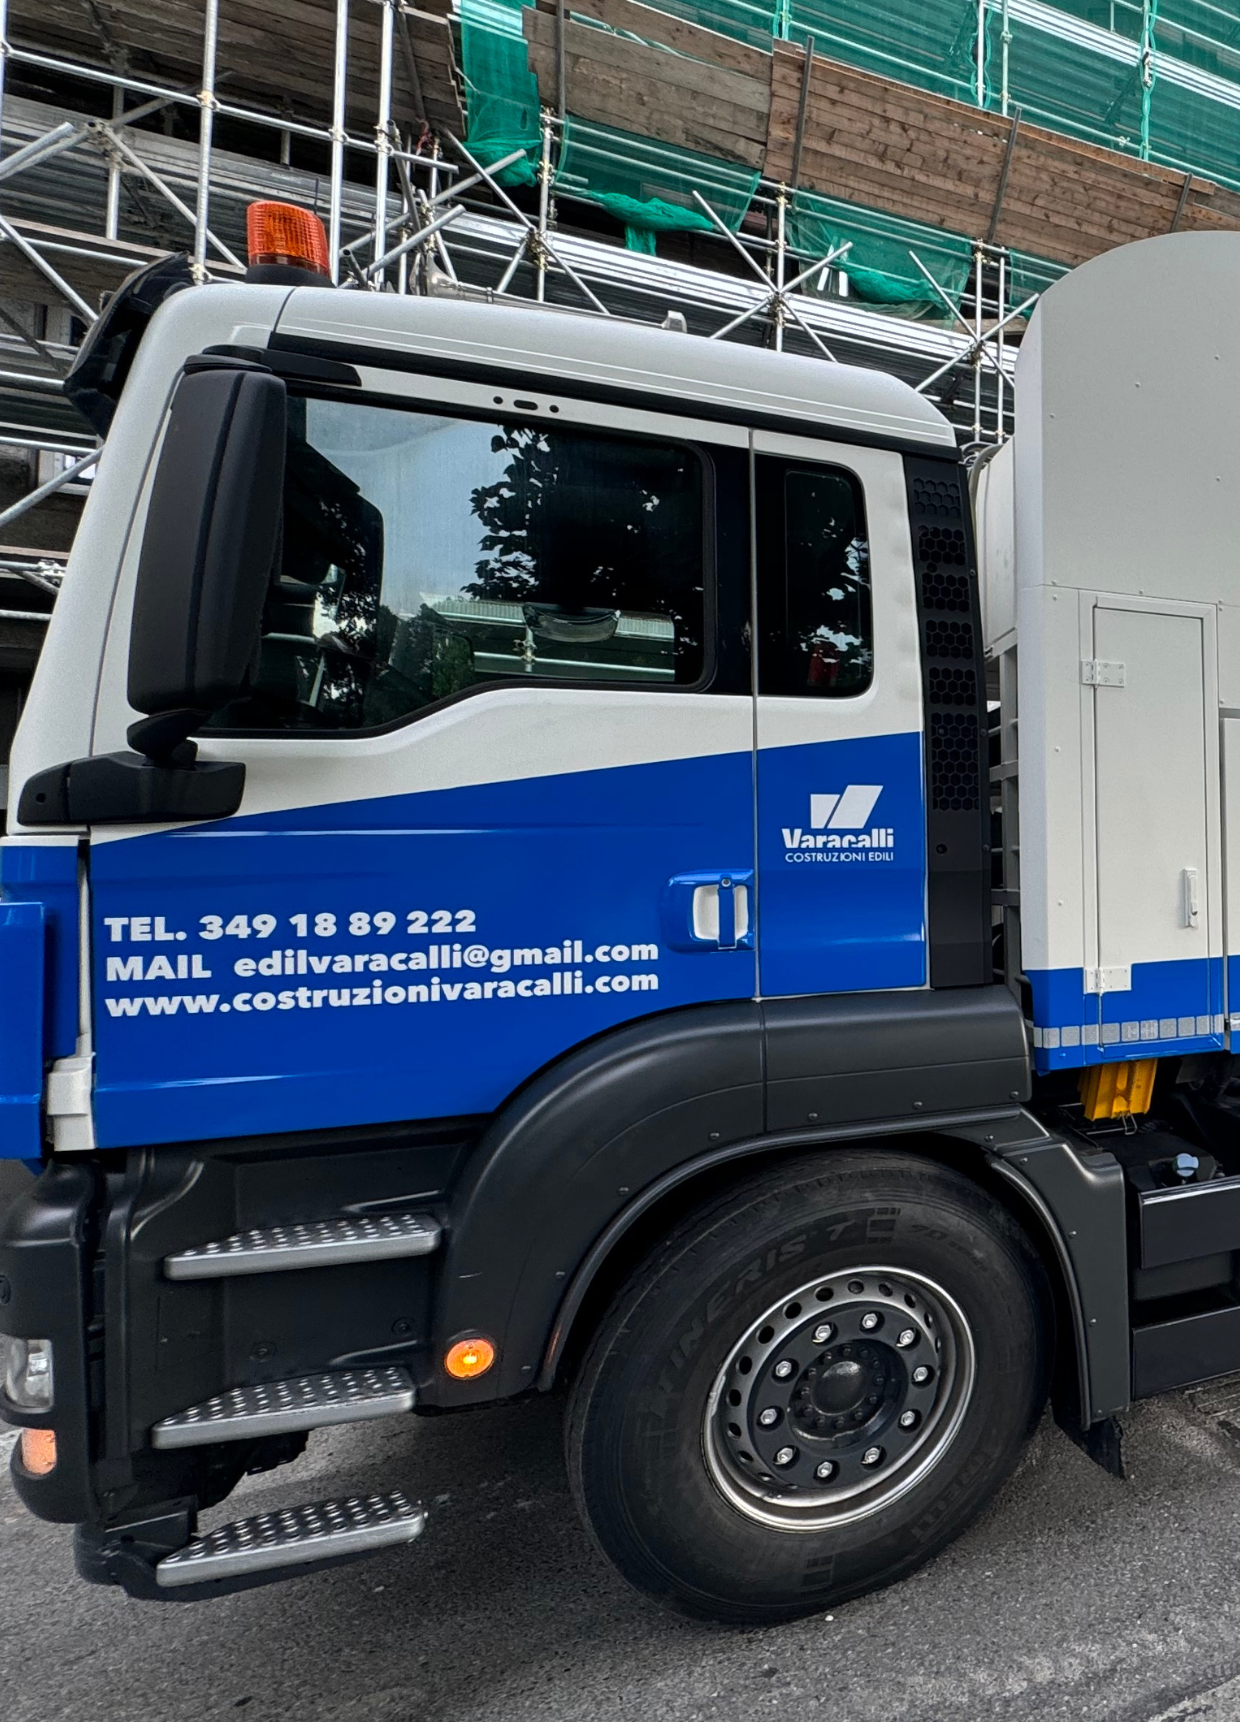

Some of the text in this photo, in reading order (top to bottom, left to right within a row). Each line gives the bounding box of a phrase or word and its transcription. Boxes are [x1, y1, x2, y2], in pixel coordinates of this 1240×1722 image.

[781, 828, 894, 849] Varacalli
[785, 852, 894, 863] COSTRUZIONI EDILI
[104, 909, 476, 942] TEL. 349 18 89 222
[106, 940, 658, 981] MAIL edilvaracalli@gmail.com
[105, 970, 658, 1017] www.costruzionivaracalli.com
